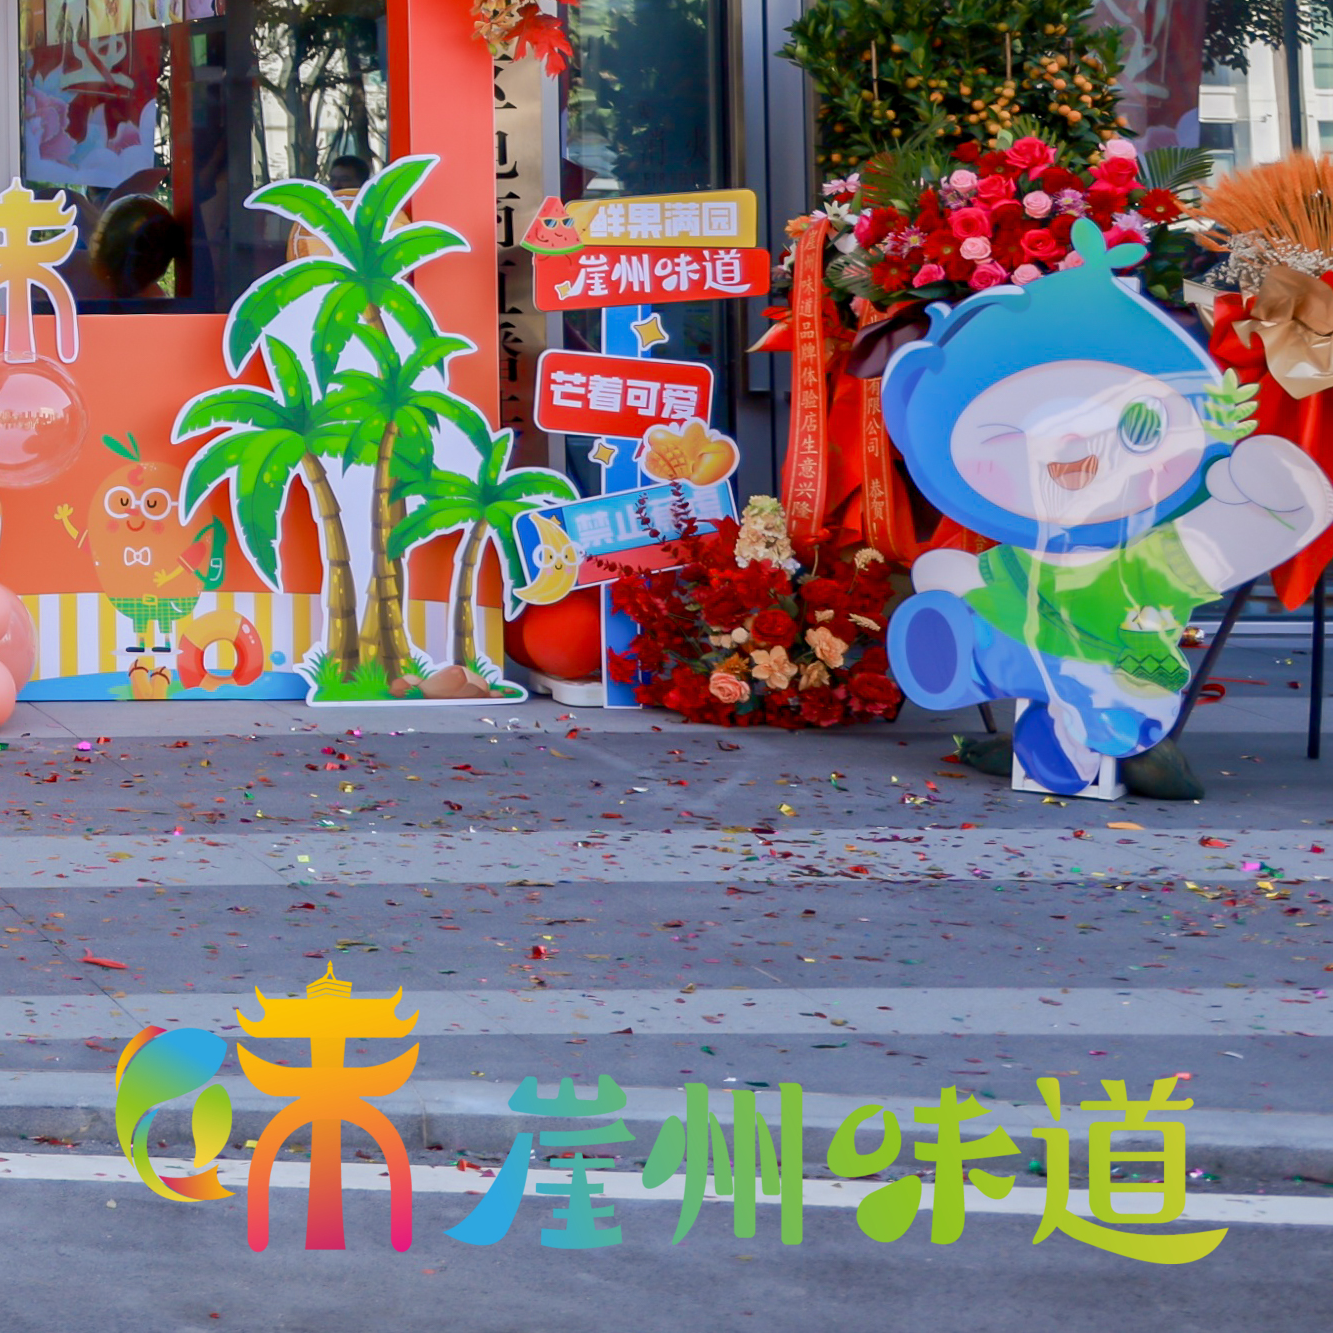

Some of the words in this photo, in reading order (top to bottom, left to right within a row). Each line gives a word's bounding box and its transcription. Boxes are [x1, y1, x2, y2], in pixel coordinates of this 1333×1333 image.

[590, 201, 738, 239] 鲜果满园
[567, 249, 751, 297] 崖州味道
[549, 370, 698, 420] 芒着可爱
